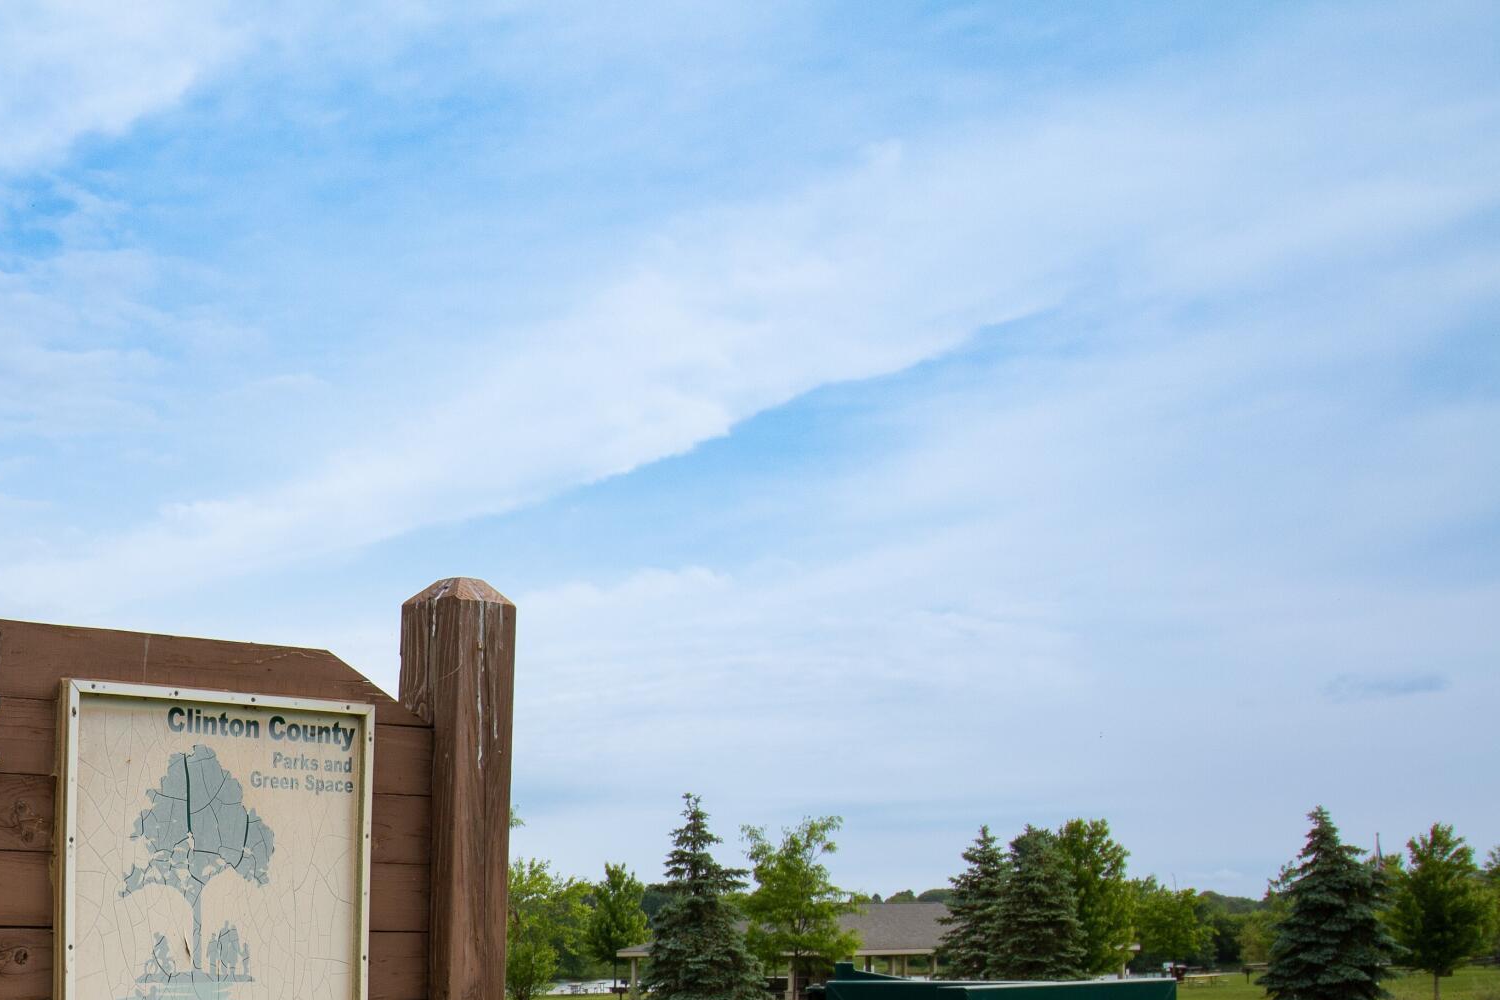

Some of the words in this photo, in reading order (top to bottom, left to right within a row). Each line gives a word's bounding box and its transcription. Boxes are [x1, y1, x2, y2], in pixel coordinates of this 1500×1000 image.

[168, 706, 259, 738] Clinton
[268, 715, 355, 751] County
[272, 751, 319, 771] Parks
[324, 757, 353, 774] and
[250, 771, 299, 790] Green
[304, 774, 354, 795] Space
